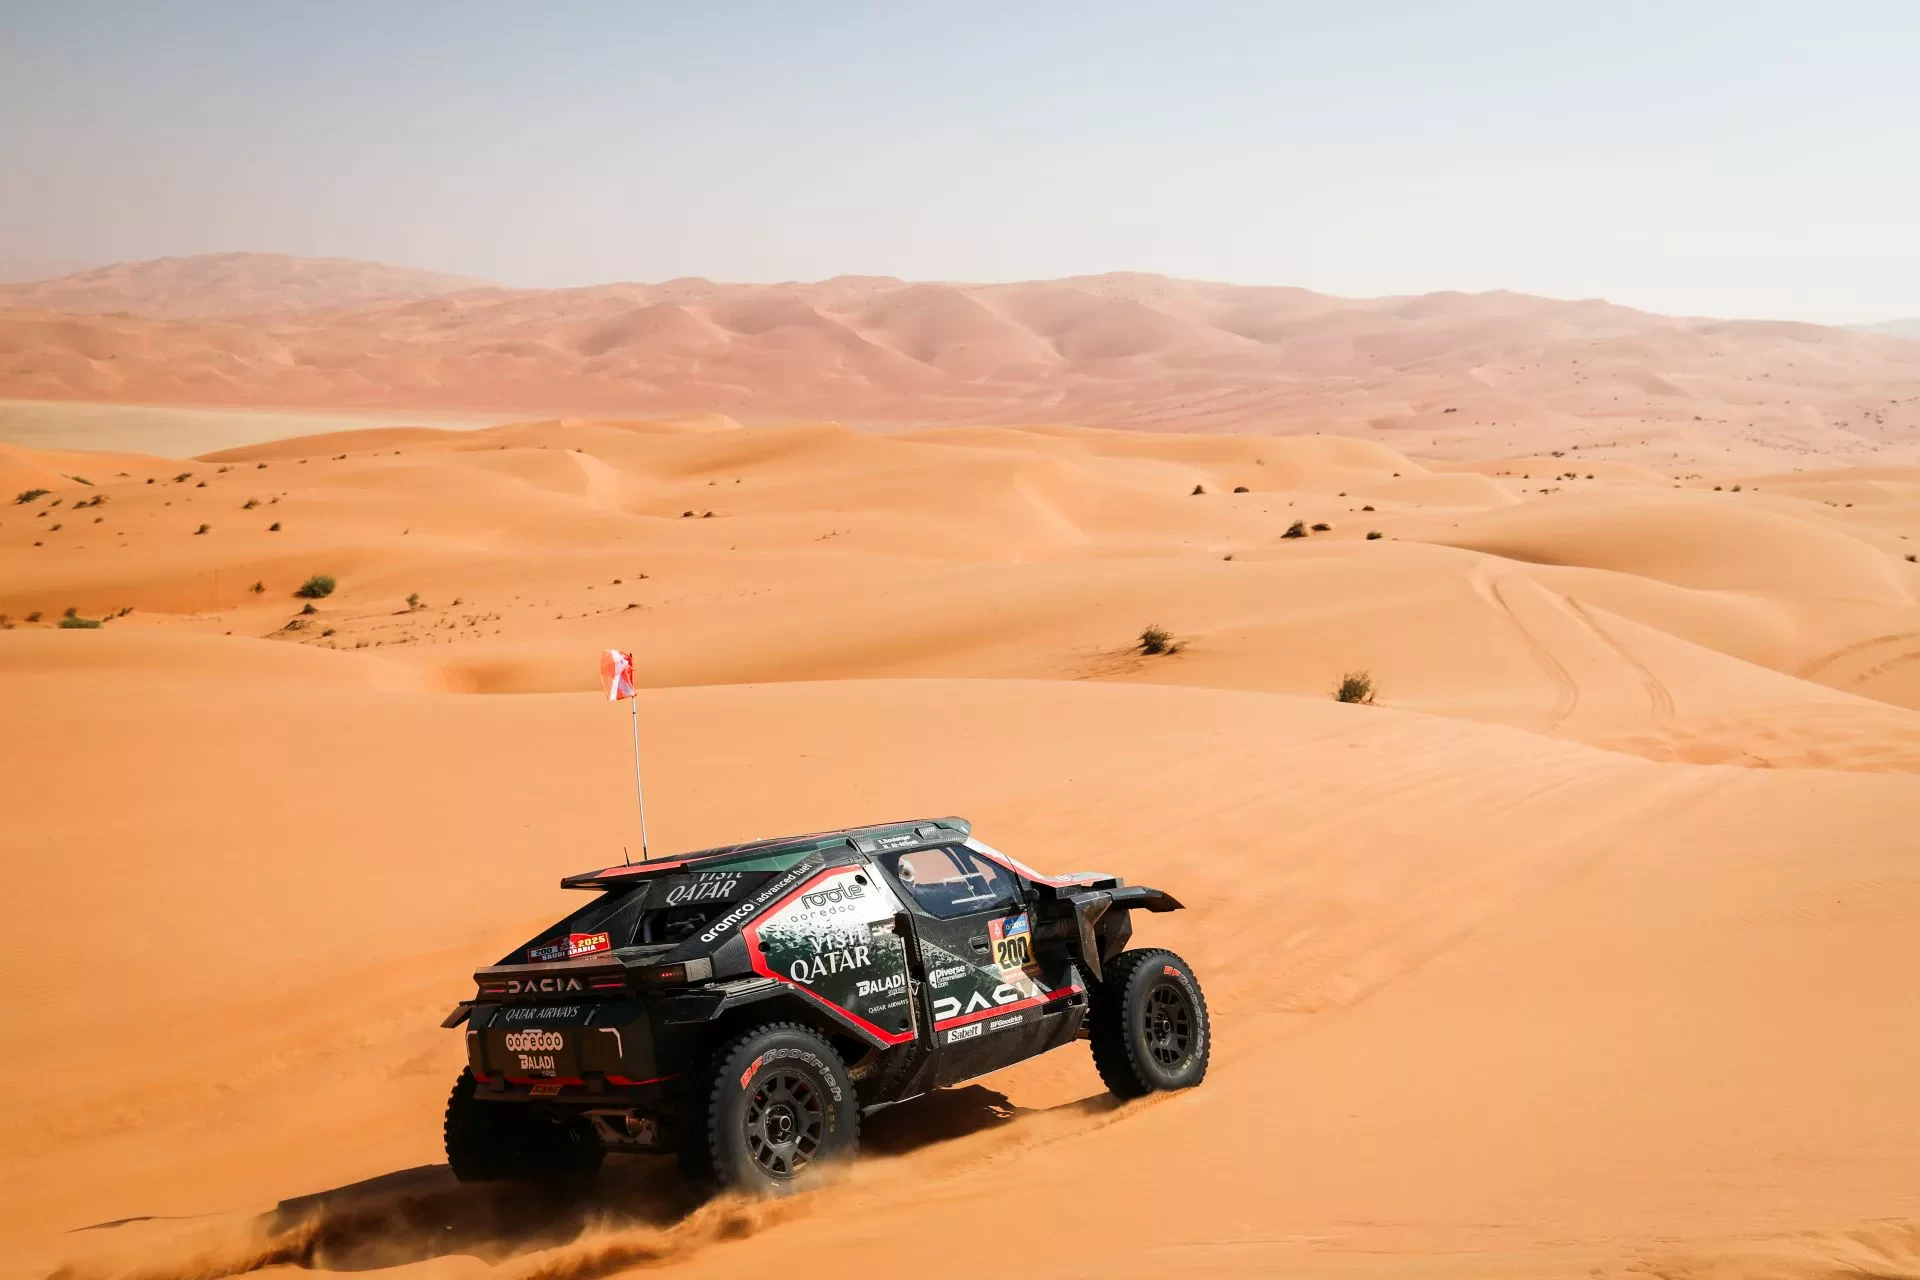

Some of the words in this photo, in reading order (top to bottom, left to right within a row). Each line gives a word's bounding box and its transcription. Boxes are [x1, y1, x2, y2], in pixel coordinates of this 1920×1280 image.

[665, 880, 737, 906] QATAR
[801, 882, 866, 910] roole
[700, 903, 755, 943] aramco
[756, 873, 796, 903] advanced
[796, 863, 813, 876] fuel
[791, 905, 855, 922] ooredoo
[578, 935, 606, 948] 2025
[535, 947, 553, 957] 200
[541, 952, 566, 961] SAUDI
[567, 944, 597, 956] ARABIA
[997, 936, 1031, 970] 200
[790, 945, 872, 985] QATAR
[936, 965, 966, 979] Diverse
[507, 978, 582, 994] DACIA
[855, 973, 906, 997] BALADI
[868, 1004, 887, 1014] QATAR
[887, 999, 909, 1009] AIRWAYS
[933, 977, 1053, 1021] DACIA
[505, 1007, 537, 1022] QATAR
[536, 1005, 581, 1019] AIRWAYS
[507, 1033, 562, 1049] ooredoo
[951, 1026, 979, 1040] Sabelt
[518, 1054, 555, 1070] BALADI
[740, 1048, 842, 1102] BFGoodrich
